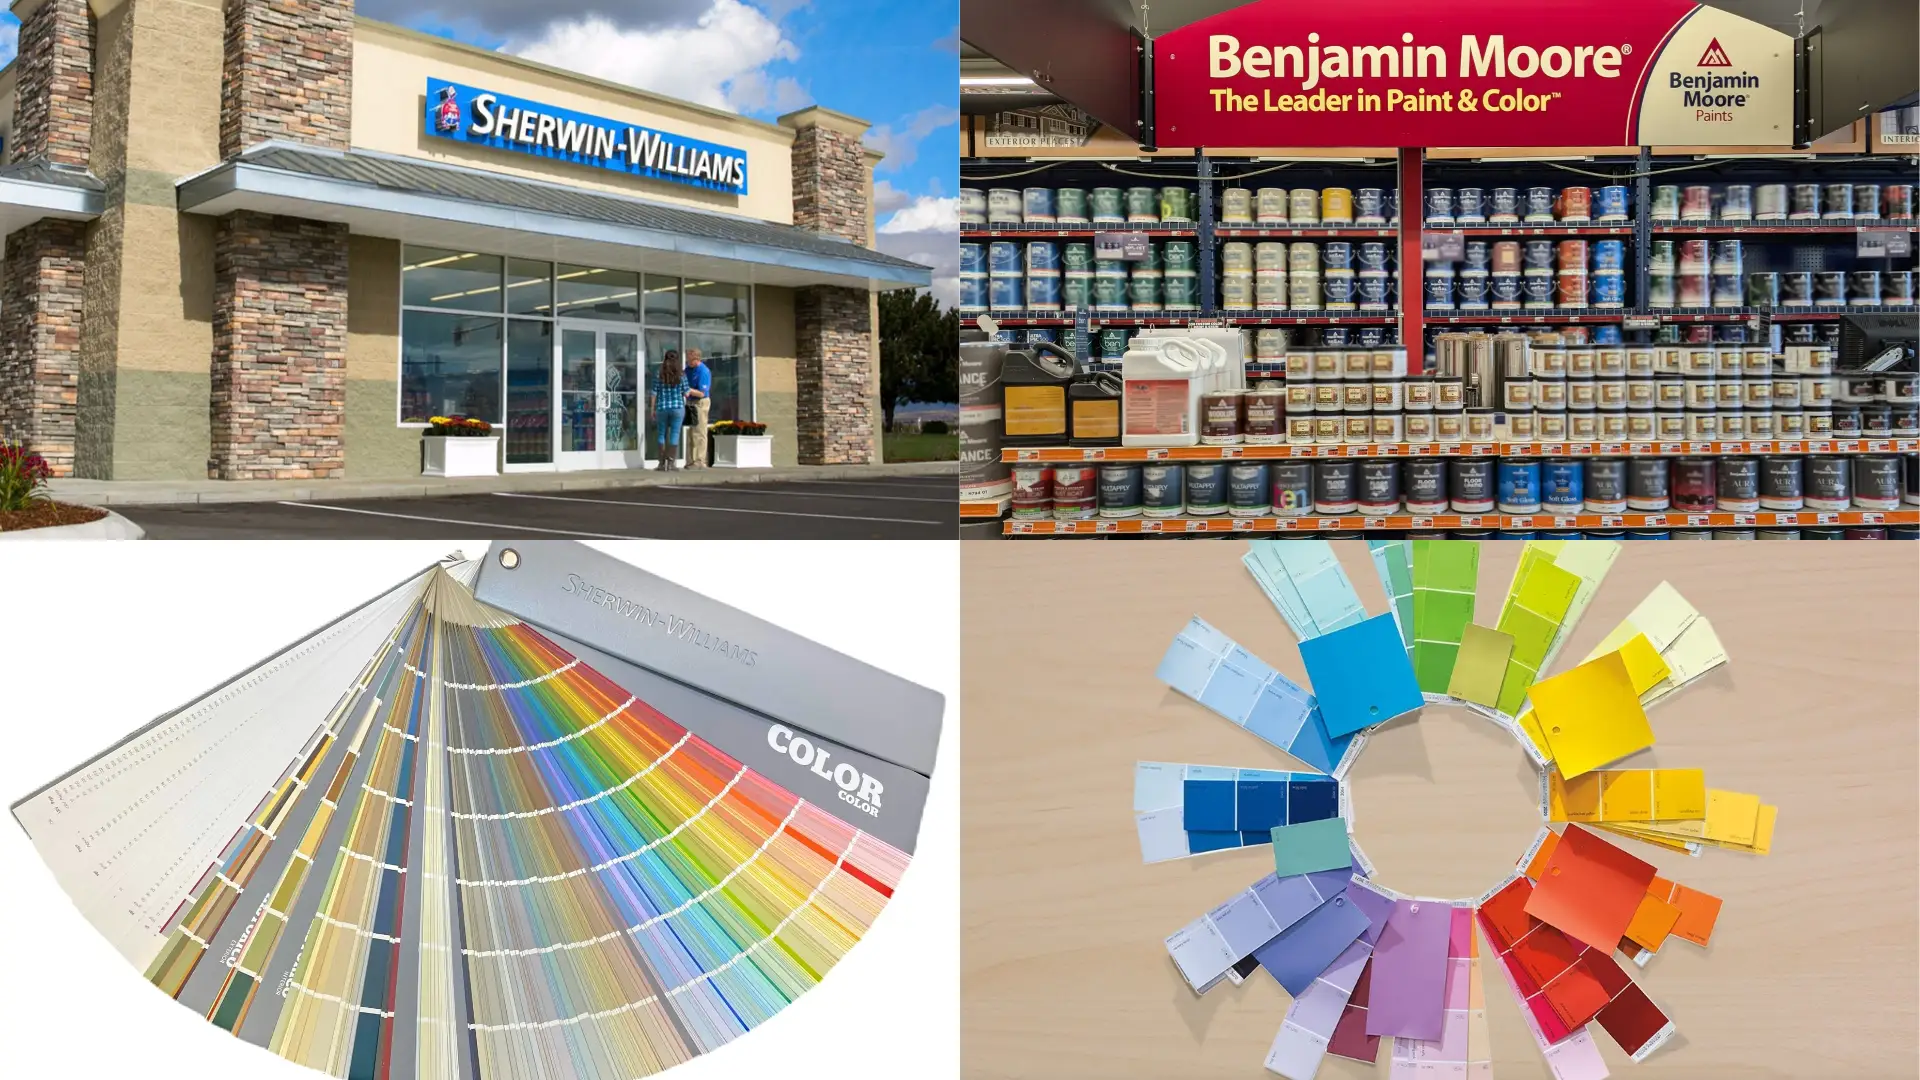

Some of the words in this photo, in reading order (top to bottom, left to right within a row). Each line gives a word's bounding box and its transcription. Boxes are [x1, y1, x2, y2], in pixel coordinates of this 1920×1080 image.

[1209, 33, 1447, 90] Benjamin
[1669, 72, 1759, 95] Benjamin
[1209, 89, 1260, 112] The
[1265, 88, 1352, 112] Leader
[1357, 88, 1382, 112] in
[1387, 89, 1453, 112] Paint
[1459, 90, 1478, 112] &
[1695, 108, 1734, 122] Paints
[472, 94, 745, 186] SHERWIN-WILLIAMS
[989, 137, 1036, 146] EXTERIOR
[562, 573, 759, 668] SHERWIN-WILLIAMS
[767, 723, 884, 808] COLOR
[837, 790, 879, 818] COLOR
